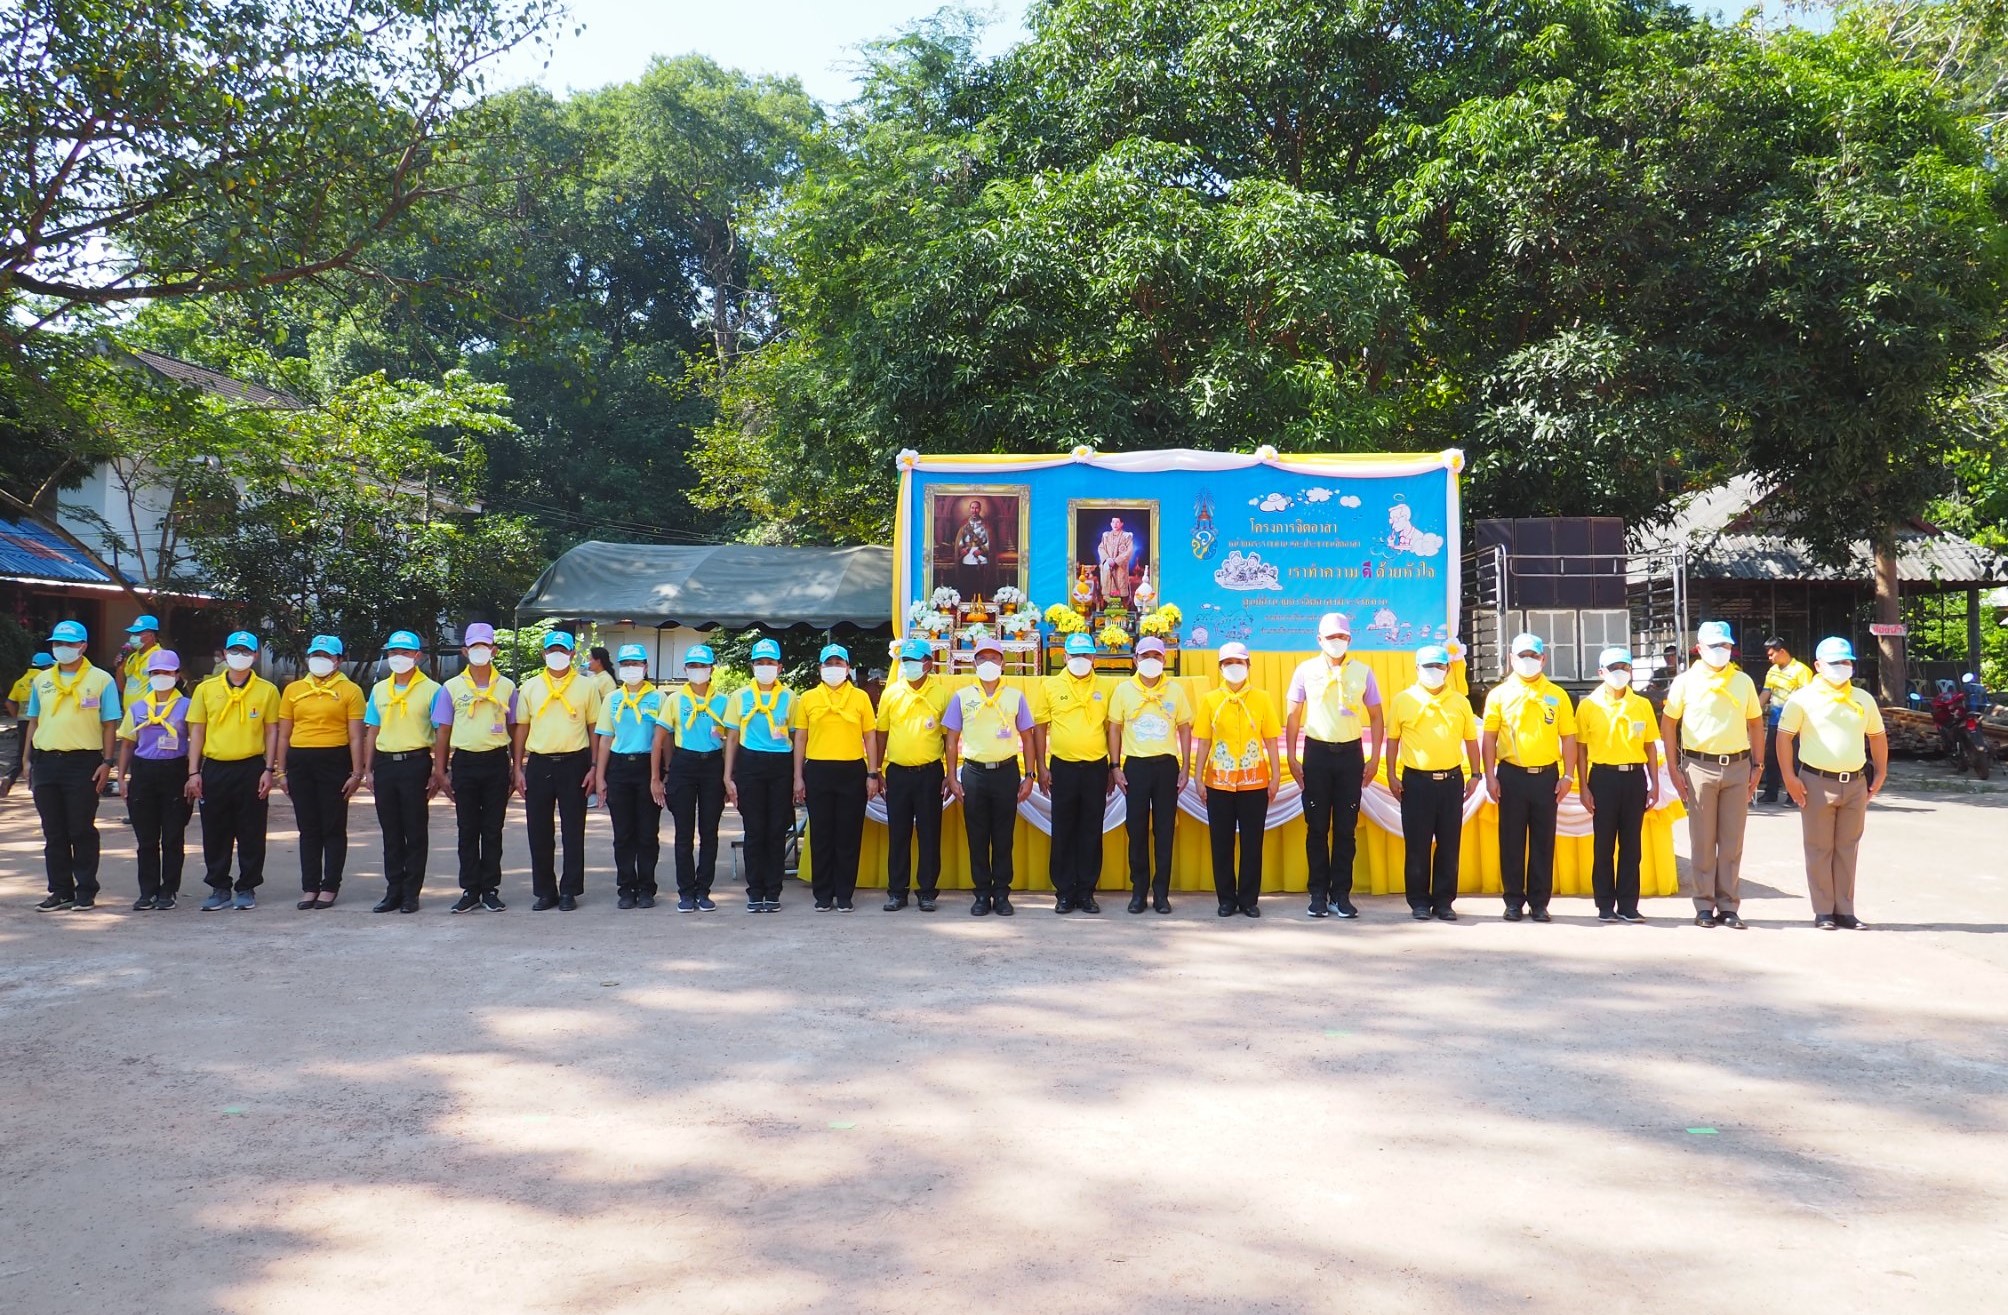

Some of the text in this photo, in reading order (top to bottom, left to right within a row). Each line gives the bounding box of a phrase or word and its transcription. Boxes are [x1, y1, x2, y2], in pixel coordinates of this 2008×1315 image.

[1249, 517, 1337, 533] โครงการจิตอาสา
[1288, 560, 1435, 579] เราทำความ ดี ด้วยหัวใจ
